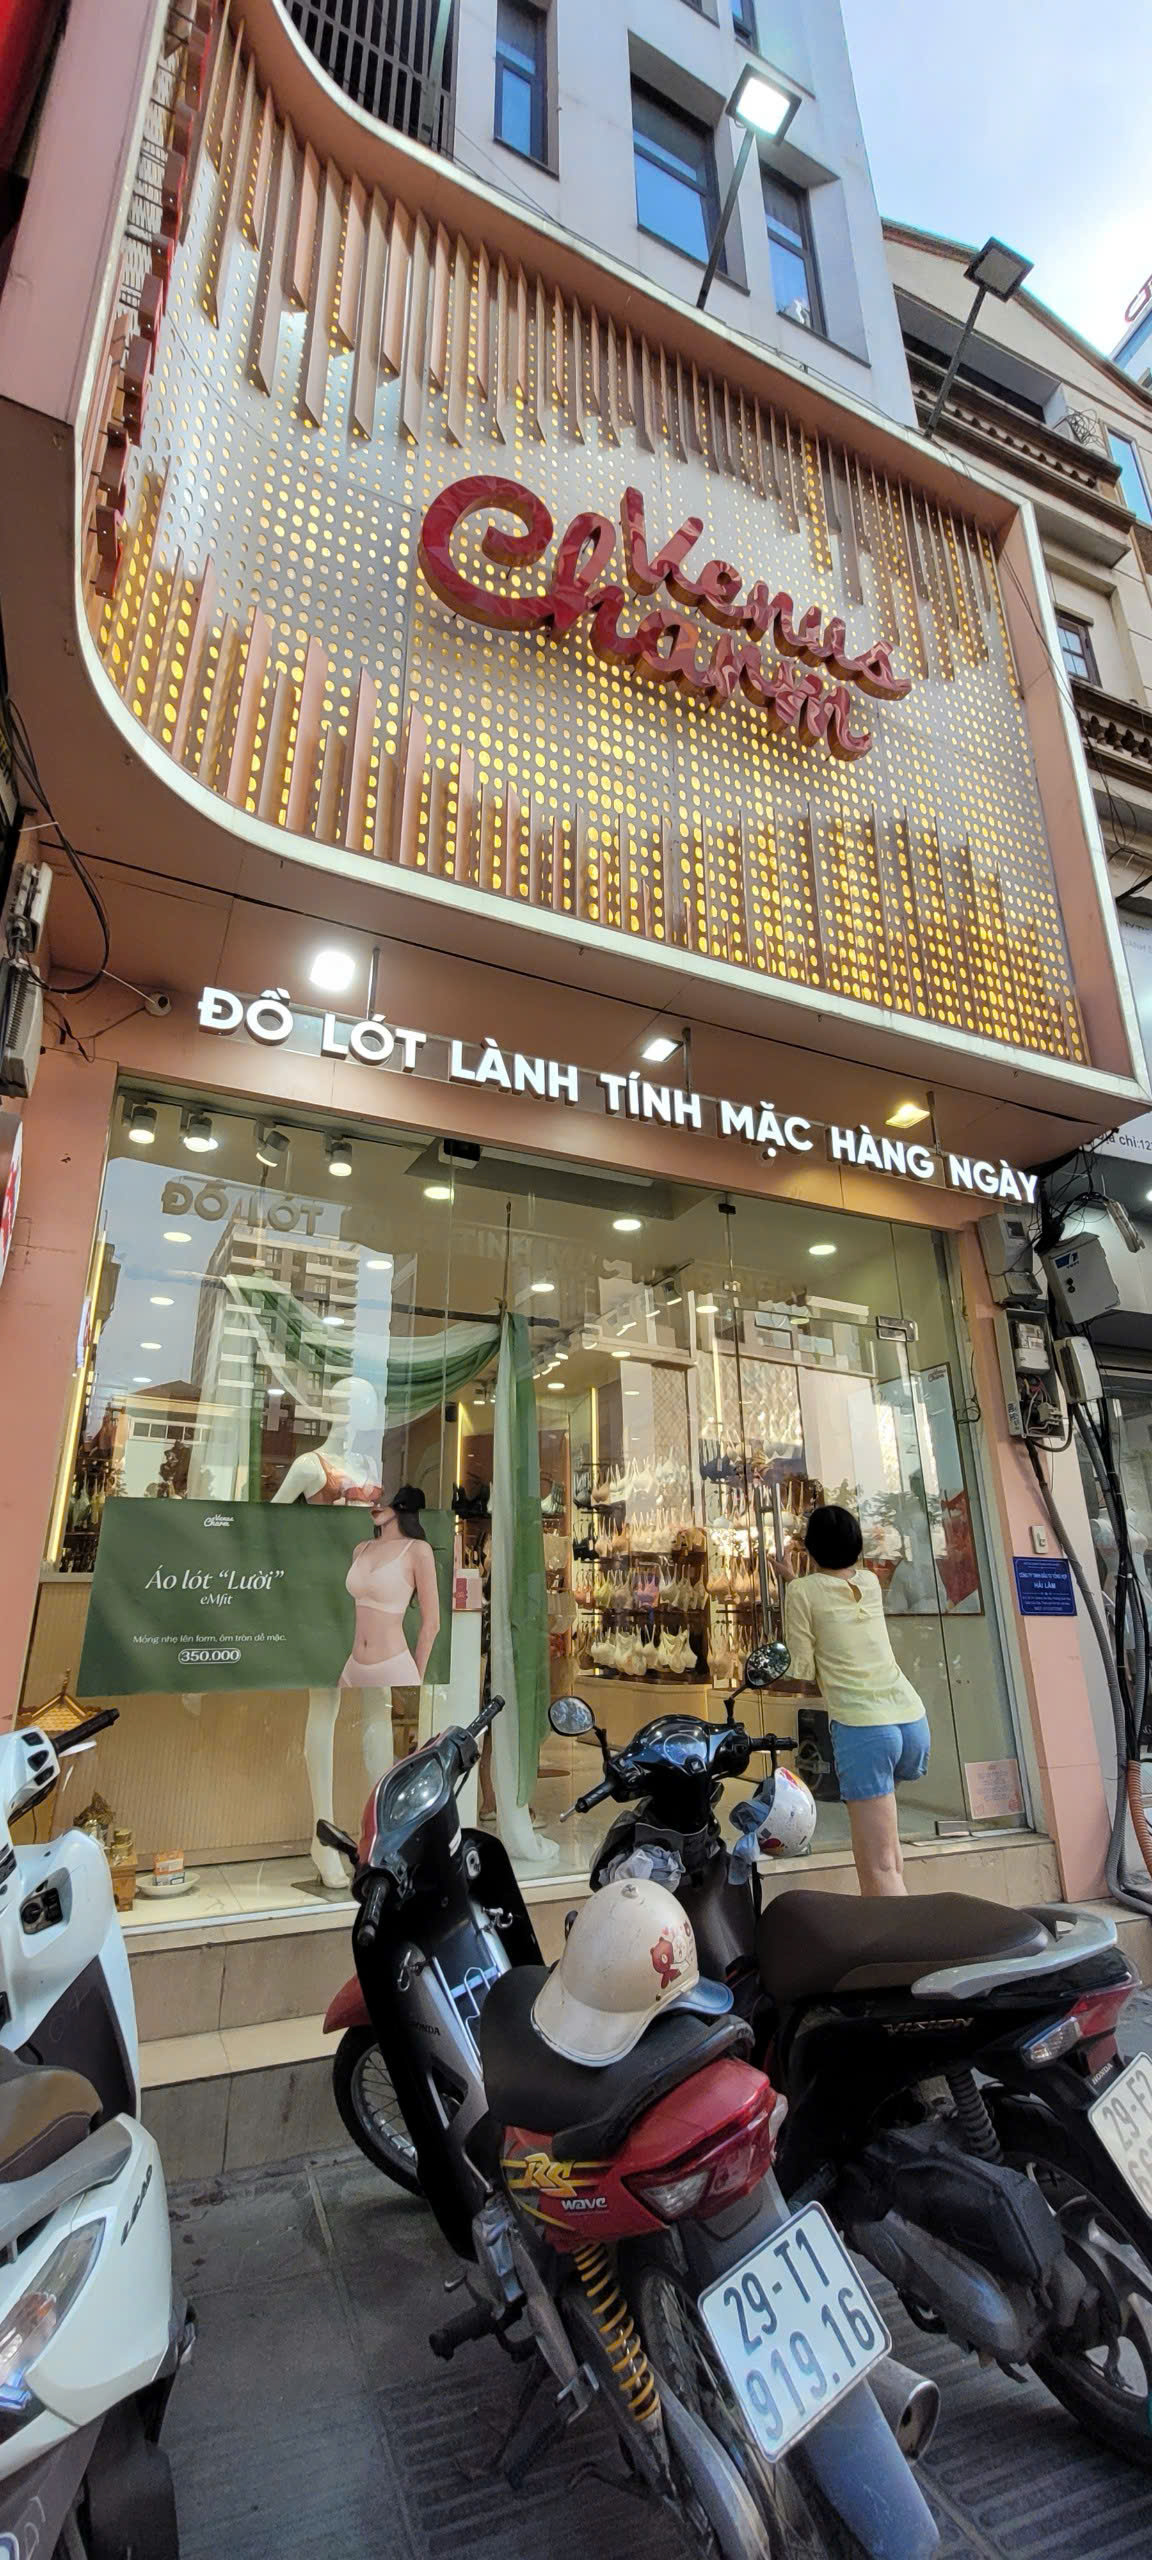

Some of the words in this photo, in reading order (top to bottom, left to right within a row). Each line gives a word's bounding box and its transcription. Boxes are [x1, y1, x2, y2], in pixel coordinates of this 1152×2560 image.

[417, 475, 872, 762] Charm
[620, 486, 912, 700] Venus
[198, 987, 293, 1045] ĐỒ
[321, 1013, 427, 1073] LÓT
[449, 1037, 579, 1106] LÀNH
[597, 1071, 702, 1130] TÍNH
[718, 1101, 814, 1160] MẶC
[825, 1124, 935, 1179] HÀNG
[945, 1154, 1039, 1203] NGÀY
[144, 1564, 177, 1590] Áo
[181, 1569, 213, 1590] lót
[200, 1593, 233, 1607] eMfit
[180, 1649, 240, 1662] 350.000
[1091, 2062, 1114, 2086] HONDA
[120, 2163, 153, 2247] LEAD
[723, 2227, 831, 2356] 29-T1
[746, 2287, 876, 2441] 919.16
